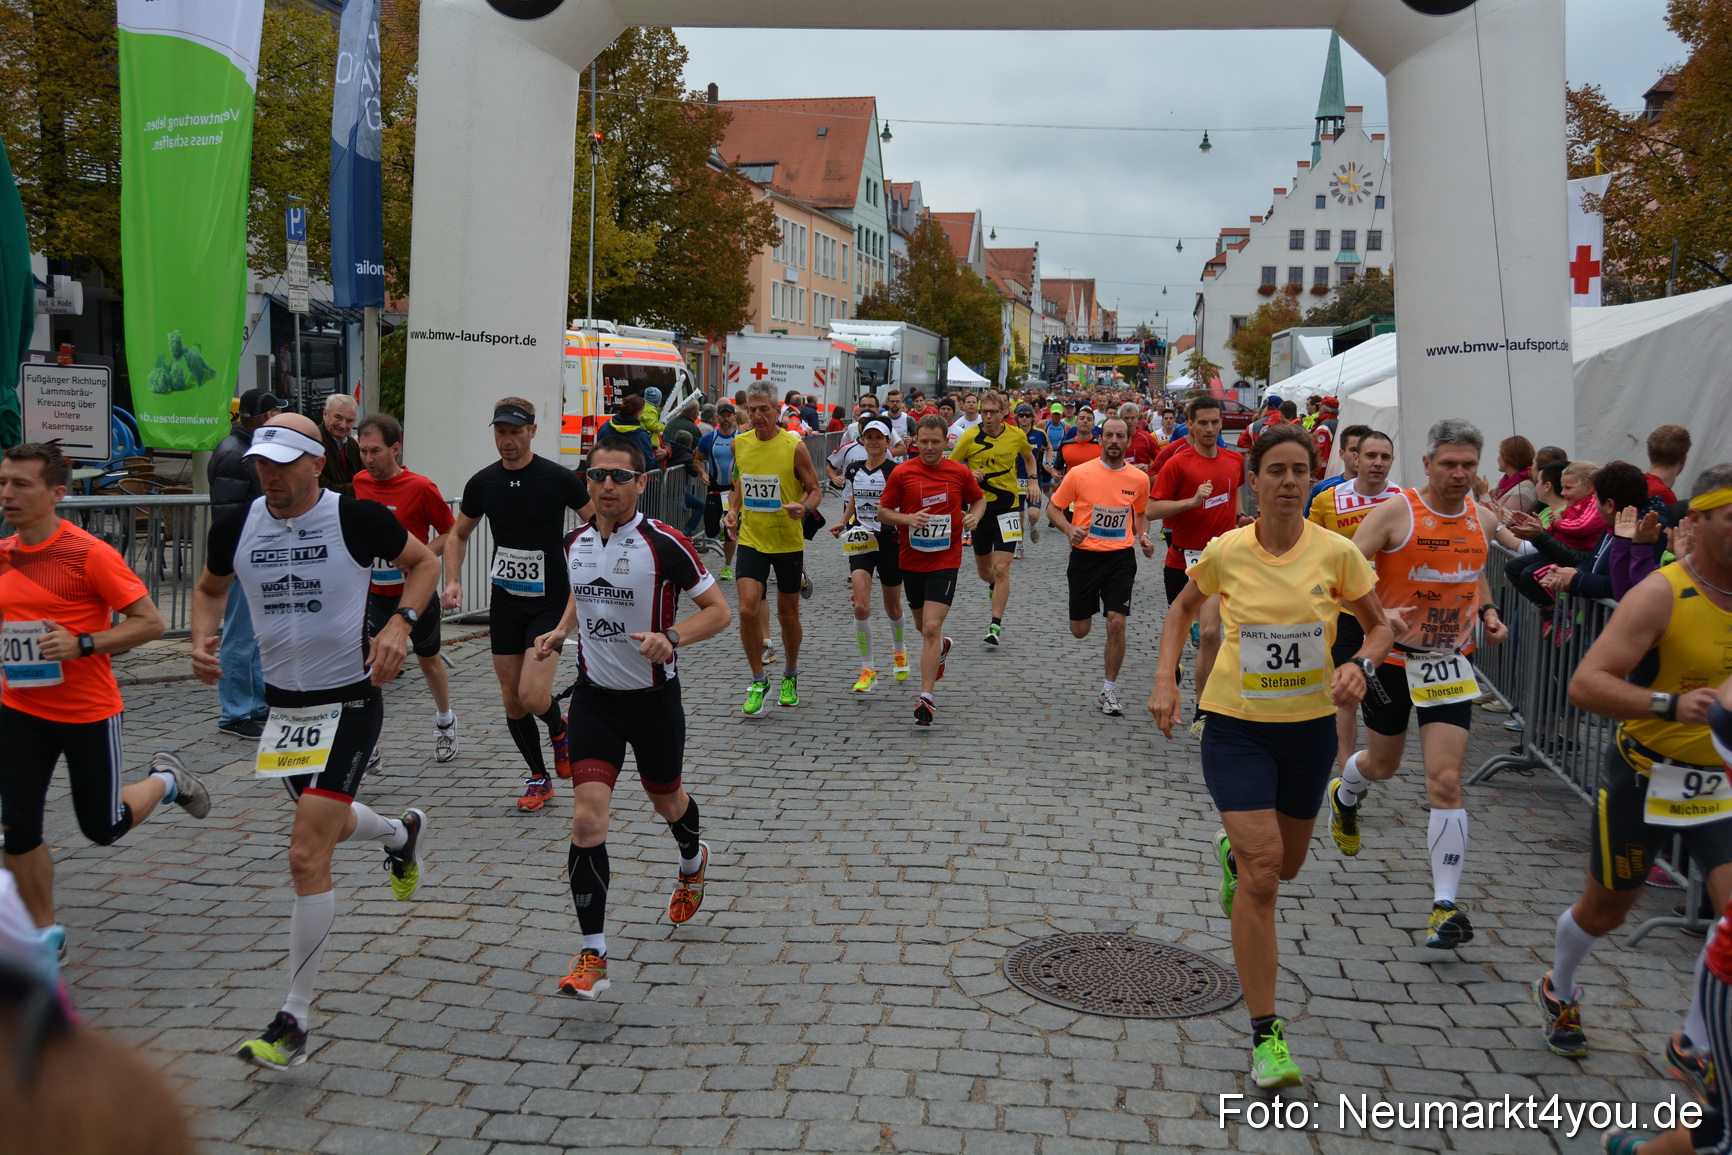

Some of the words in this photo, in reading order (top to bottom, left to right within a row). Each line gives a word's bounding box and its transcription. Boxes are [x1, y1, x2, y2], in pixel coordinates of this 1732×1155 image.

[410, 328, 537, 346] www.bmw-laufsport.de
[1426, 338, 1569, 356] www.bmw-laufsport.de
[26, 374, 70, 385] Fußgänger
[72, 376, 106, 387] Richtung
[40, 387, 93, 396] Lammsbräu-
[38, 398, 75, 409] Kreuzung
[78, 400, 96, 408] über
[54, 410, 81, 419] Untere
[42, 422, 93, 432] Kaserngasse
[745, 483, 776, 498] 2137
[1095, 514, 1126, 528] 2087
[914, 524, 947, 537] 2677
[253, 546, 324, 562] POSITIV
[496, 559, 539, 580] 2533
[261, 581, 321, 592] WOLFRUM
[573, 585, 634, 599] WOLFRUM
[1427, 607, 1461, 624] RUN
[1420, 623, 1438, 632] FOR
[1440, 624, 1459, 633] YOUR
[1241, 631, 1268, 639] PARTL
[1266, 643, 1301, 670] 34
[1421, 658, 1461, 683] 201
[1261, 676, 1306, 688] Stefanie
[1426, 686, 1464, 698] Thorsten
[276, 724, 323, 749] 246
[277, 755, 310, 767] Werner
[1682, 771, 1722, 800] 92
[1670, 803, 1720, 816] Michael
